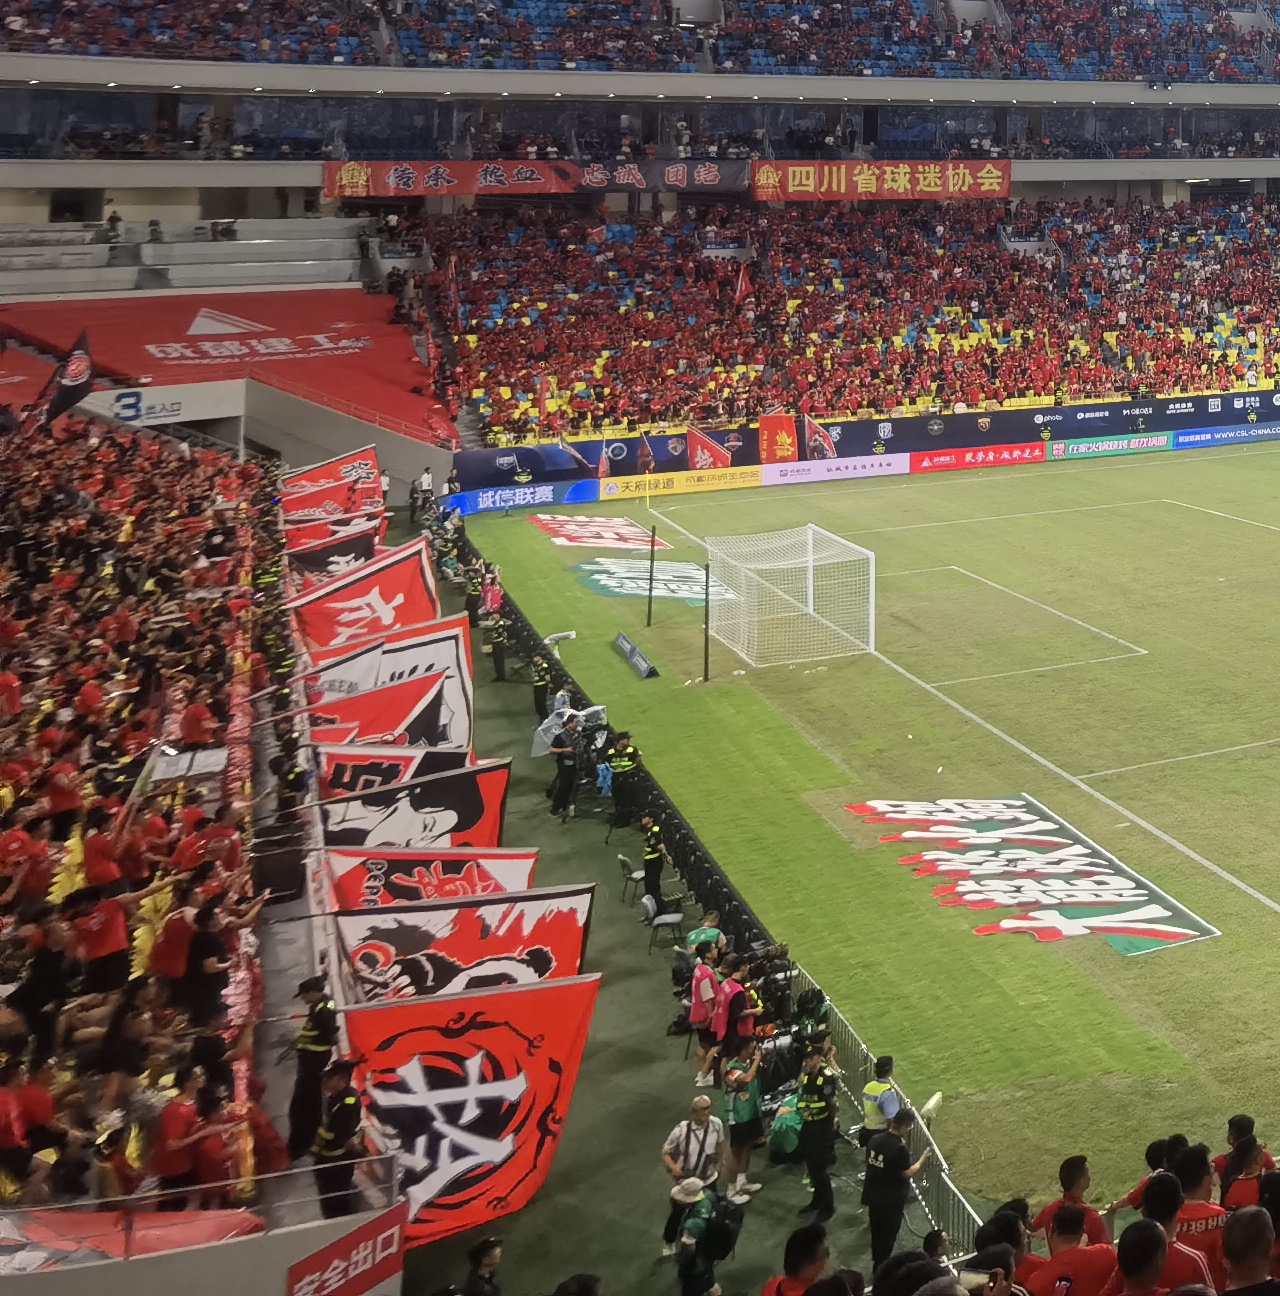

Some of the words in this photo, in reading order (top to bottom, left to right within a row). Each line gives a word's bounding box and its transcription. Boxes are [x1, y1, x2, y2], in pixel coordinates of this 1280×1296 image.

[478, 163, 545, 188] 热血
[788, 163, 1004, 194] 四川省球迷协会
[113, 391, 143, 422] 3
[476, 485, 554, 509] 诚信联赛
[293, 1224, 400, 1296] 安全出口
